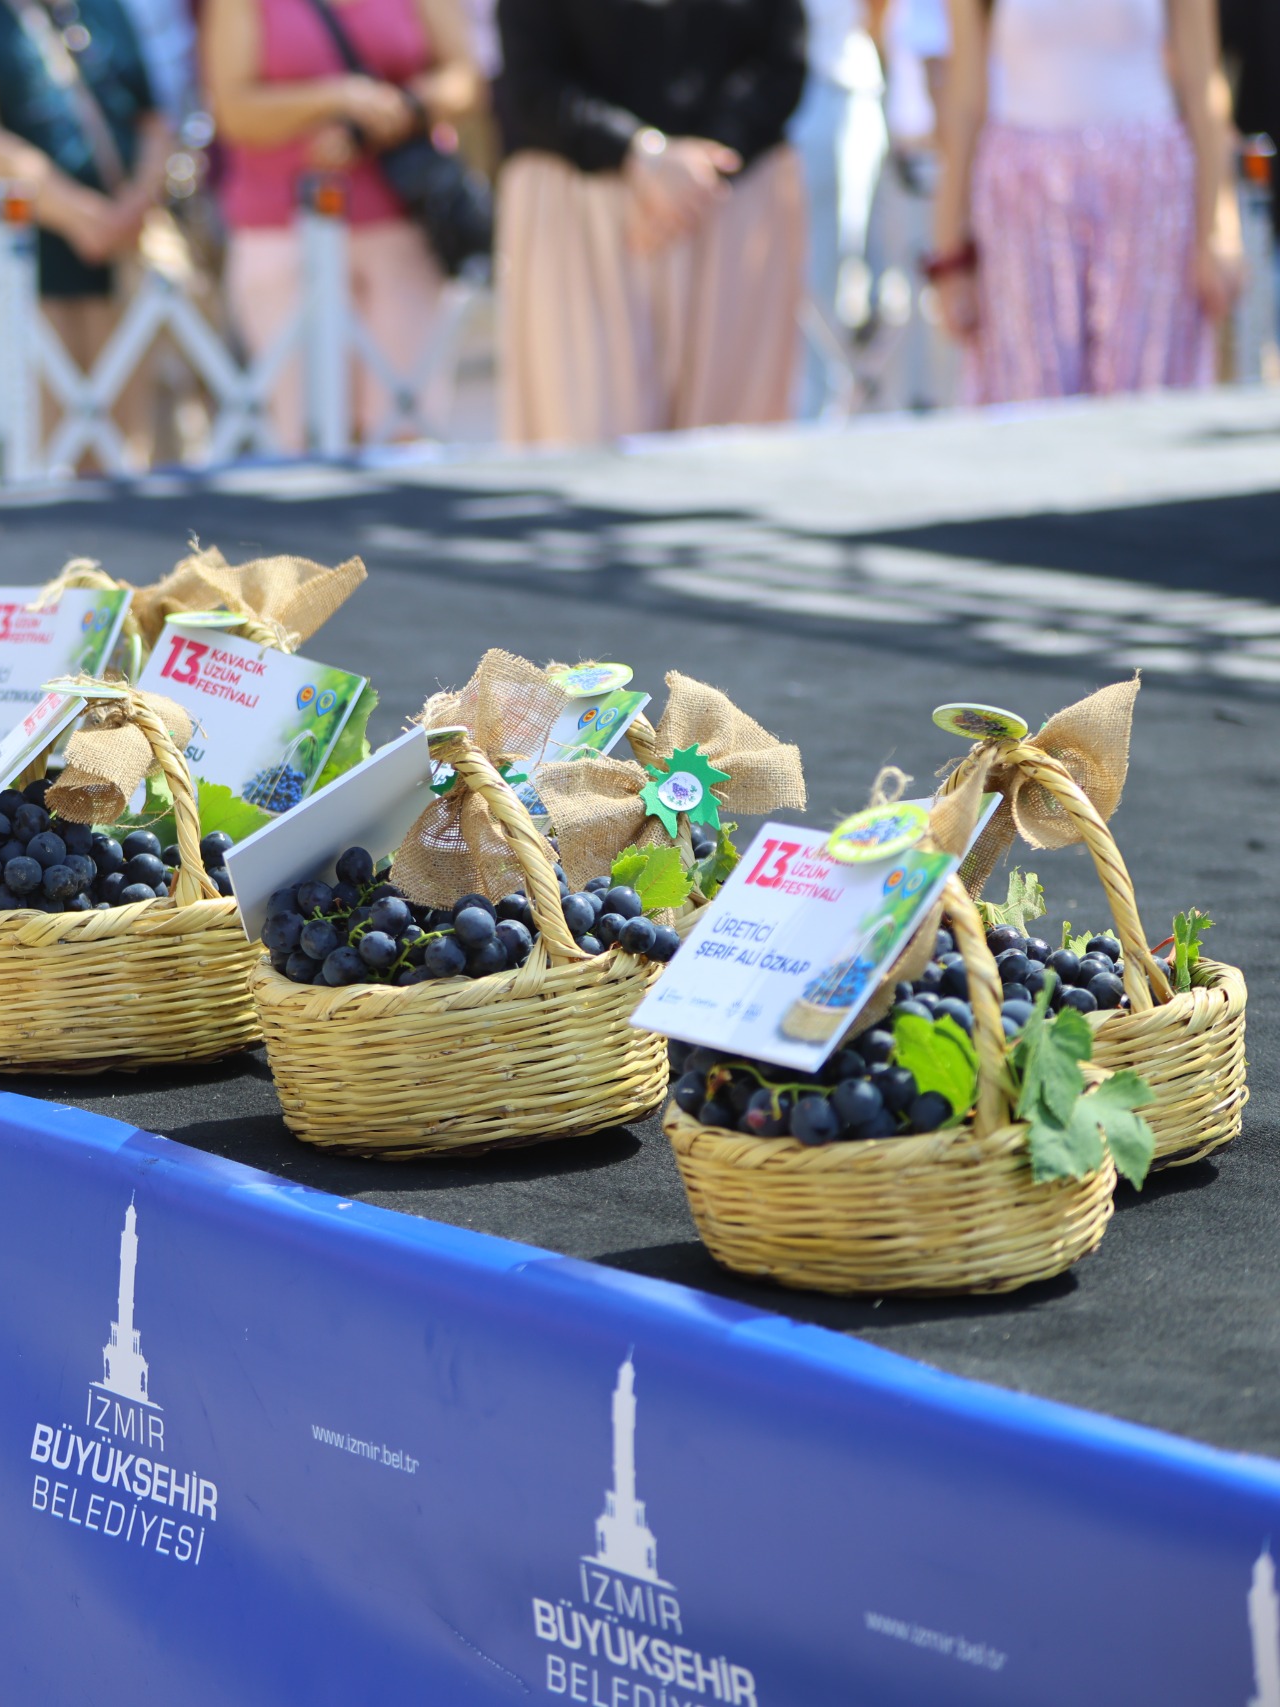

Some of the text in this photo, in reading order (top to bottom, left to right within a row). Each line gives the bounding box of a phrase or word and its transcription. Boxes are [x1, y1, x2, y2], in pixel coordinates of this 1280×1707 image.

[210, 648, 269, 677] KAVACIK
[711, 912, 780, 944] ÜRETİCİ
[85, 1388, 166, 1453] İZMİR
[311, 1423, 421, 1475] www.izmir.bel.tr
[29, 1422, 219, 1523] BÜYÜKŞEHİR
[31, 1474, 207, 1566] BELEDİYESİ
[579, 1562, 684, 1636] İZMİR
[531, 1597, 758, 1707] BÜYÜKŞEHİR
